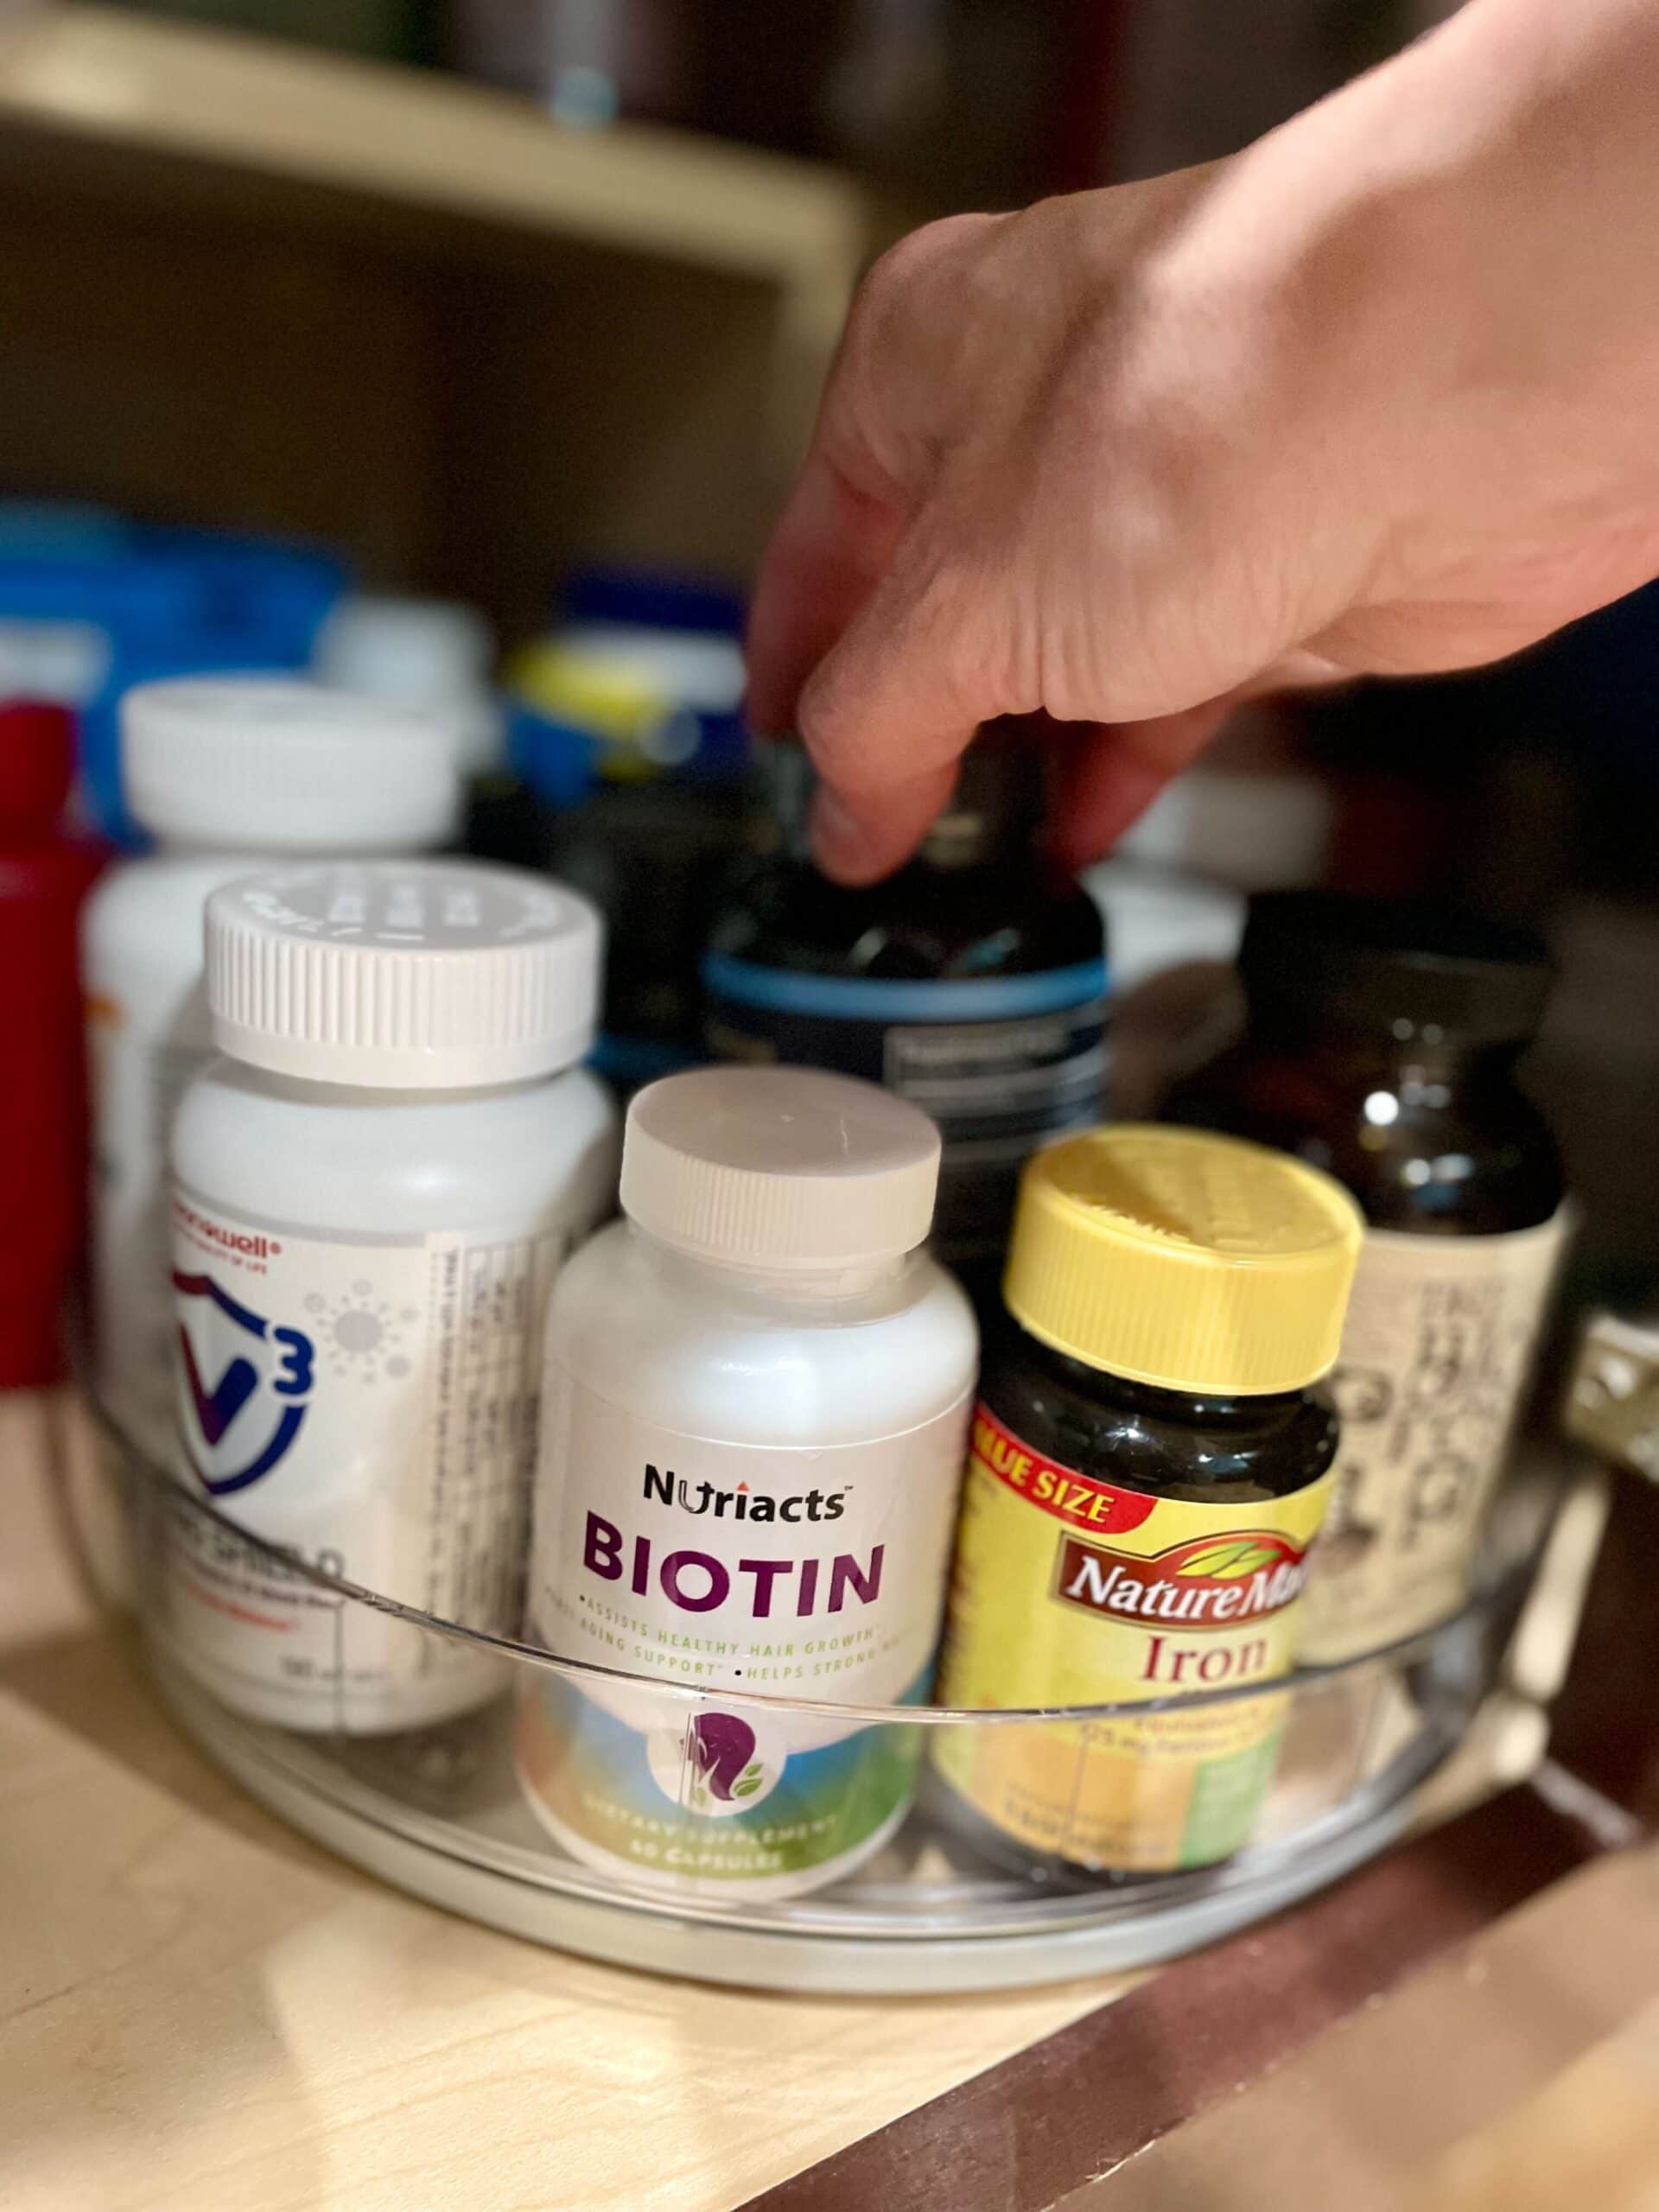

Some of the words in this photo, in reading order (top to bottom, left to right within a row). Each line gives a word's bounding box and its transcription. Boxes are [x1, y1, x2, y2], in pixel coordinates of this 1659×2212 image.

[1033, 1470, 1116, 1524] SIZE
[583, 1510, 886, 1618] BIOTIN
[658, 1630, 740, 1656] HEALTHY
[750, 1644, 794, 1657] HAIR
[1139, 1636, 1267, 1682] Iron
